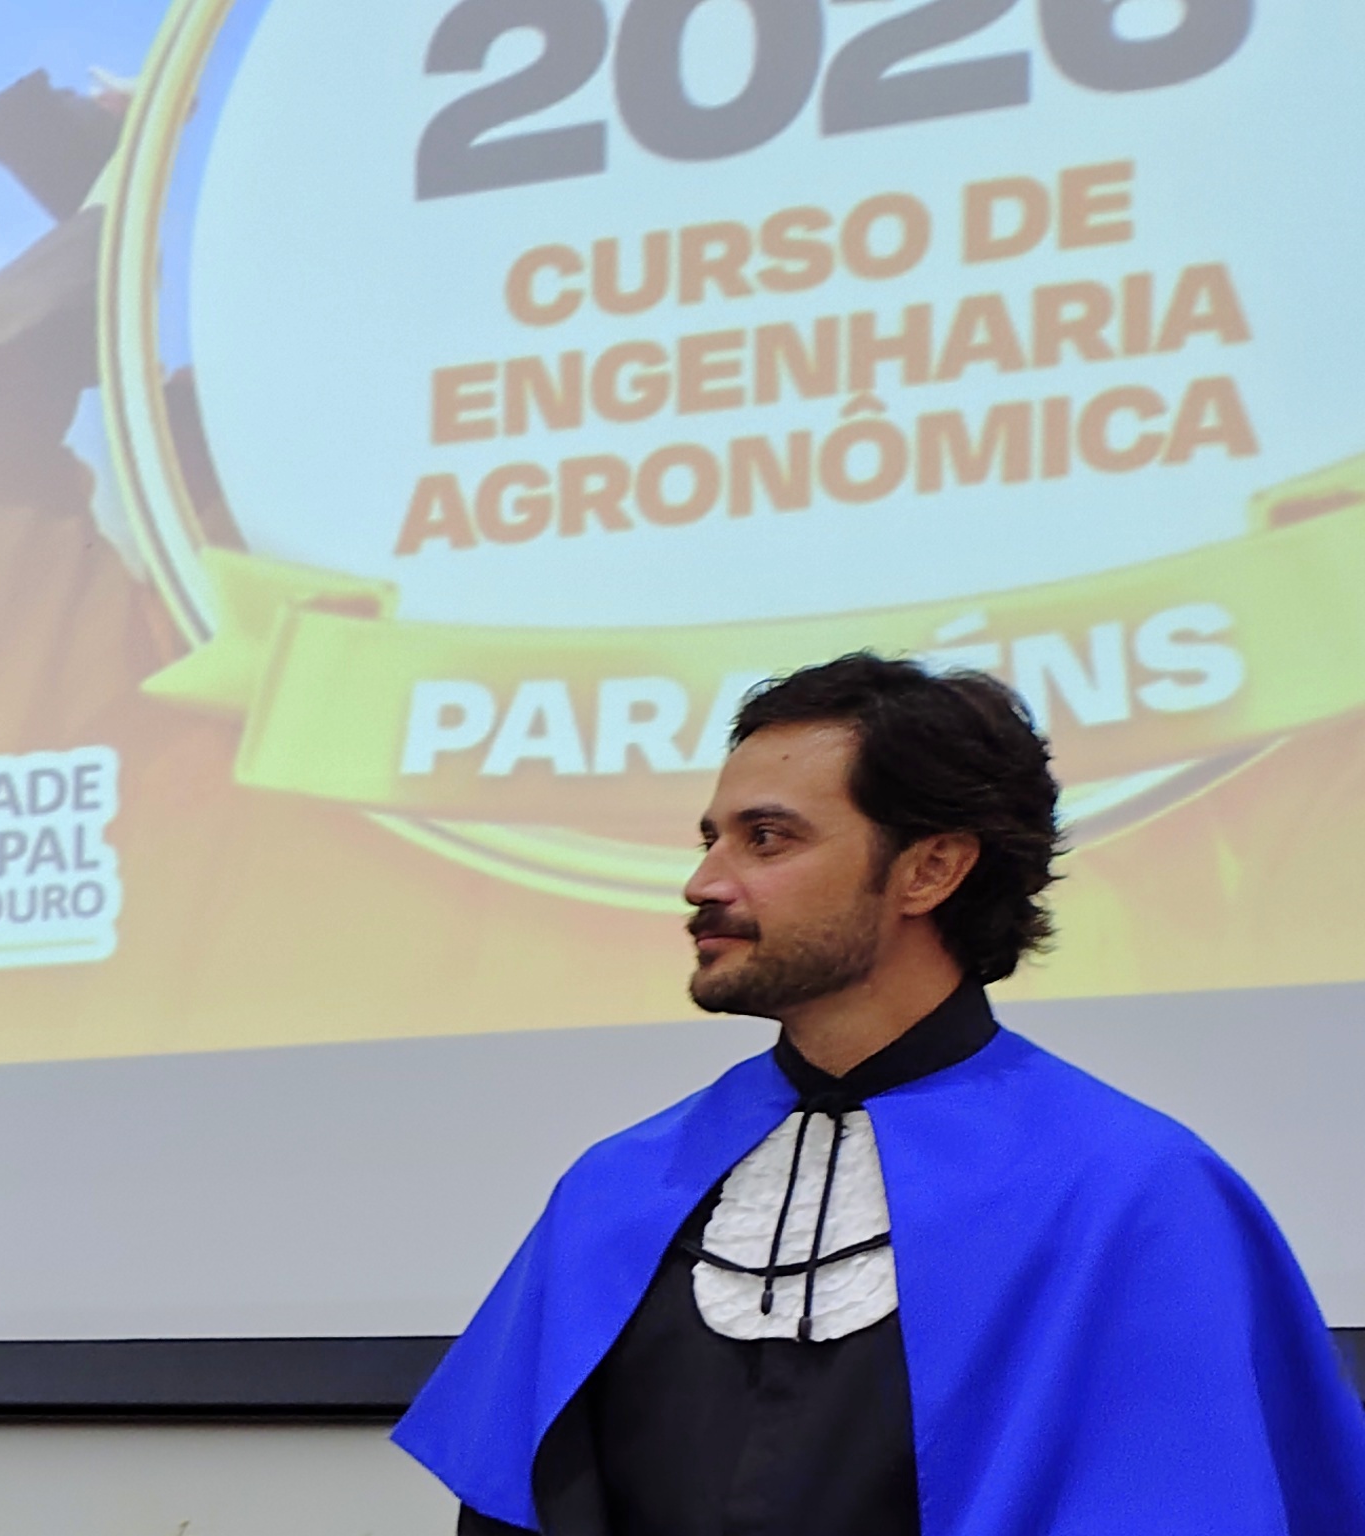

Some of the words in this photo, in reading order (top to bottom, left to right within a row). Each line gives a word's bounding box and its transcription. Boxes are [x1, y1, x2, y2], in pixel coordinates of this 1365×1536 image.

[504, 192, 933, 327] CURSO
[961, 159, 1136, 265] DE
[429, 262, 1253, 446] ENGENHARIA
[393, 375, 1259, 556] AGRONÔMICA
[400, 602, 1247, 777] PARNS
